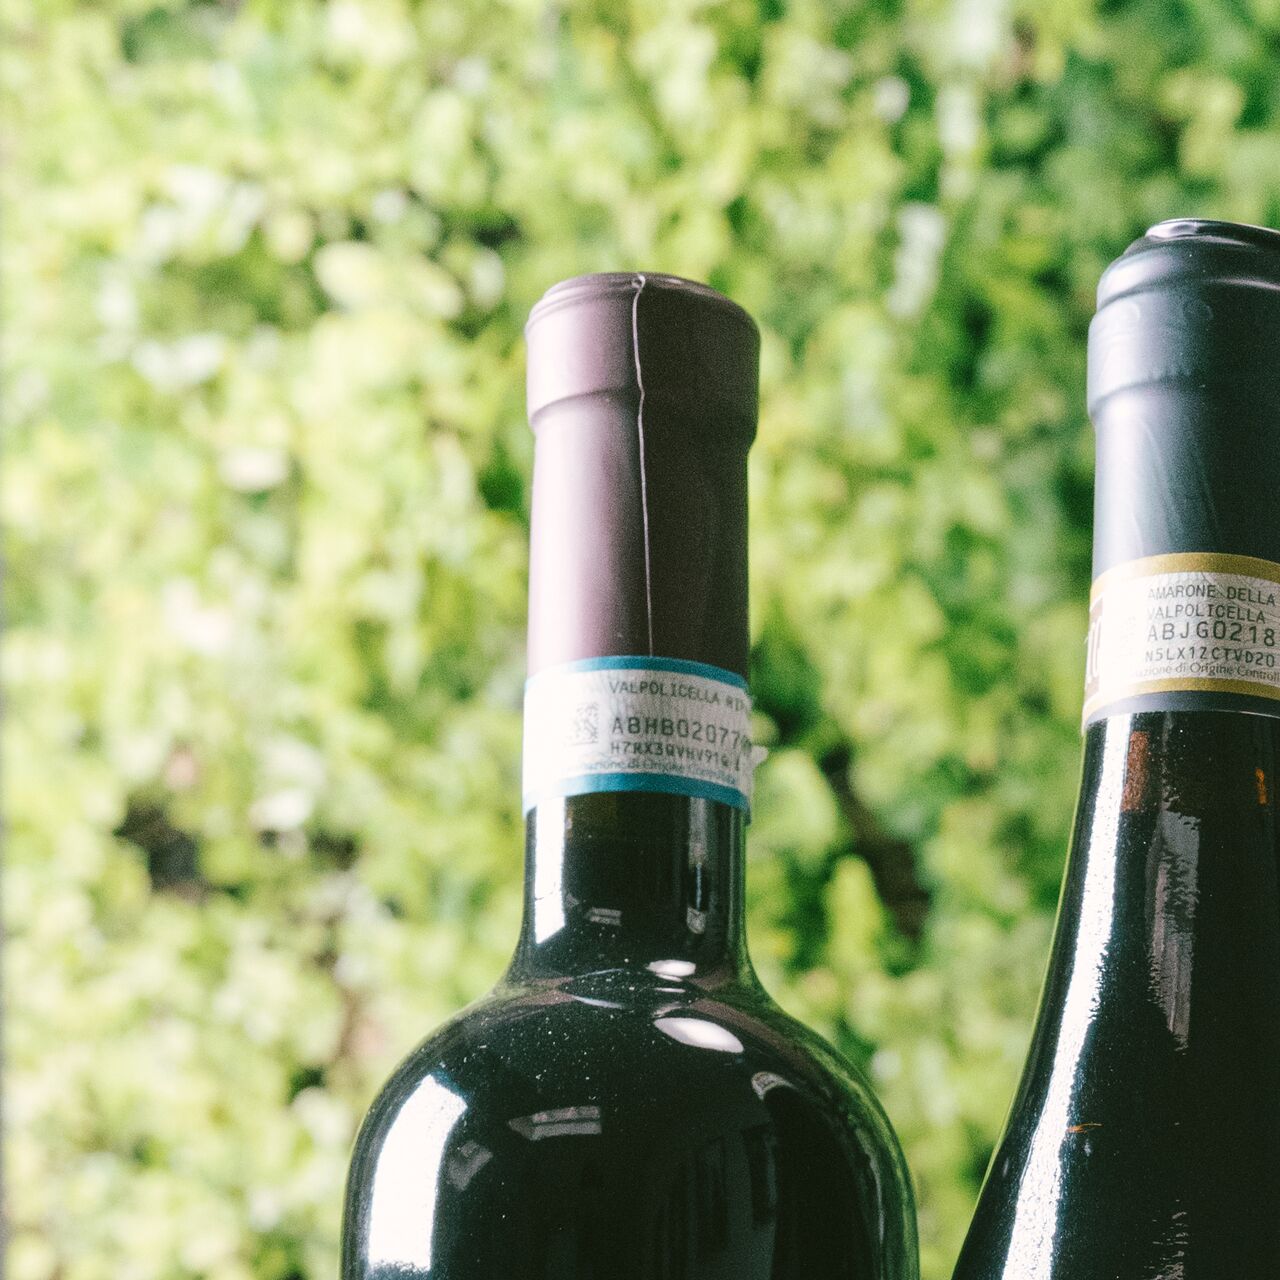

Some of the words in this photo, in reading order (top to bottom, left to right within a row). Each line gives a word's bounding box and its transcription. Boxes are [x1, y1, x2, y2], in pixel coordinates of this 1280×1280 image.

[1148, 584, 1216, 599] AMARONE
[1227, 586, 1275, 607] DELLA
[1147, 604, 1266, 624] VALPOLICELLA
[1190, 662, 1234, 676] Origine
[609, 680, 719, 703] VALPOLICELLA
